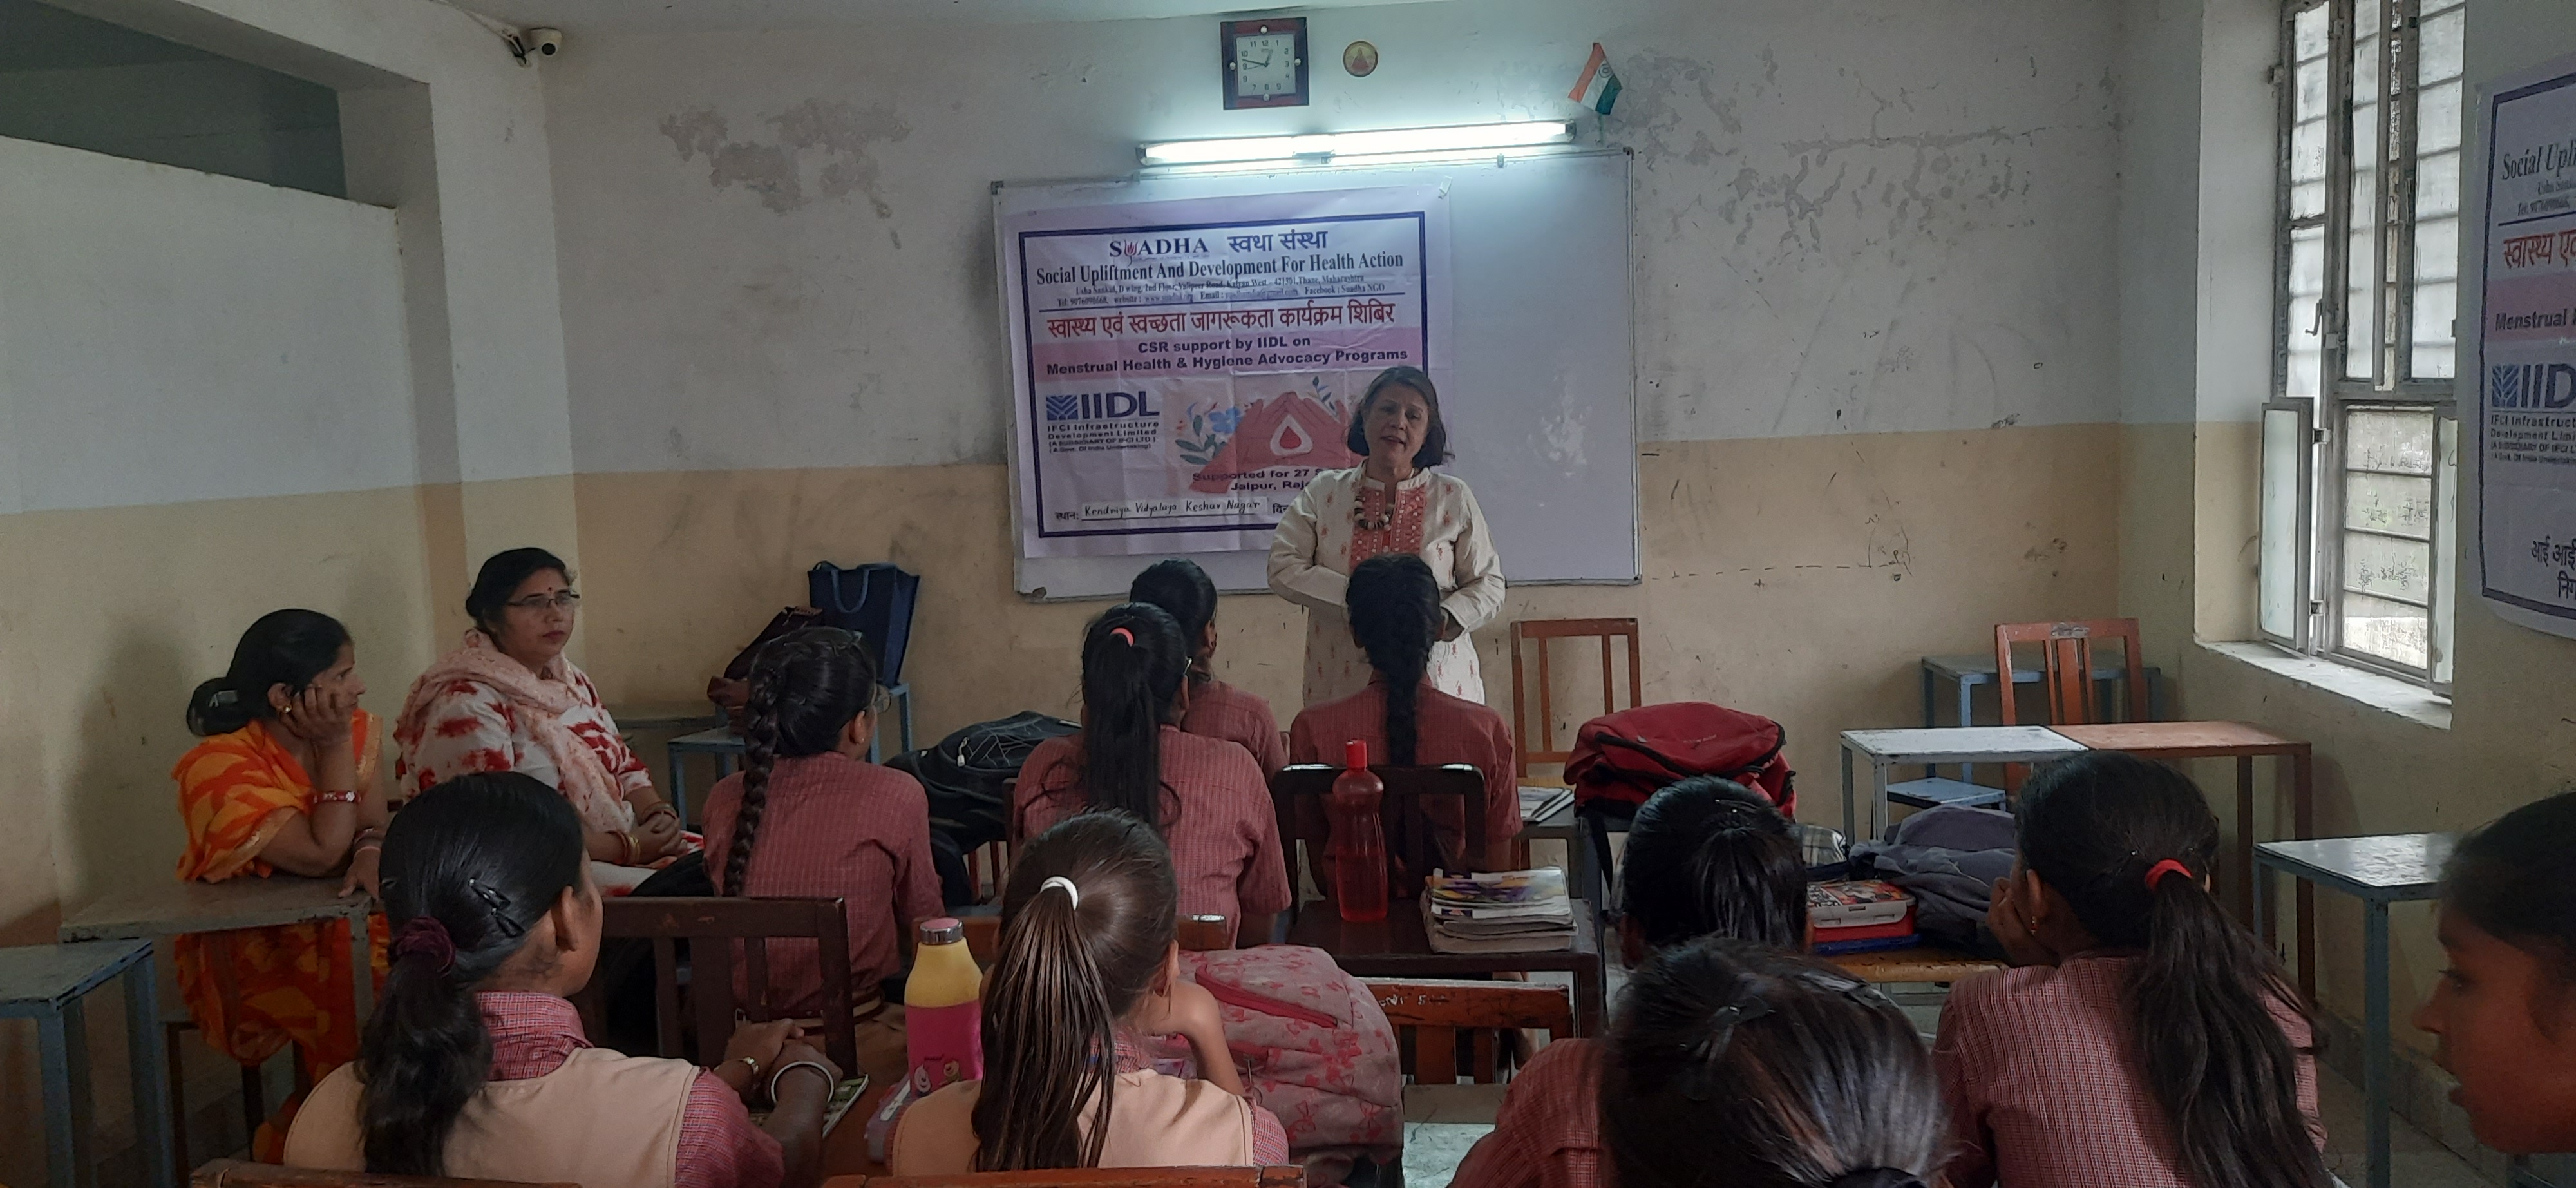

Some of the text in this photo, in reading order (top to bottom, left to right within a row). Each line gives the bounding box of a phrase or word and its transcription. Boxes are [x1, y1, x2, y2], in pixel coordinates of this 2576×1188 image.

[2502, 144, 2544, 180] Social
[1227, 228, 1329, 253] स्वधा संस्था
[2503, 232, 2556, 269] स्वास्थ्य
[1037, 251, 1404, 286] Social Upliftment And Development For Health Action
[1144, 283, 1157, 292] 2nd
[1226, 279, 1250, 289] Kalyan
[1251, 278, 1267, 287] West
[1322, 274, 1365, 284] Maharashtra
[1200, 291, 1220, 300] Email
[1304, 284, 1336, 295] Facebook
[1367, 282, 1385, 292] NGO
[1046, 298, 1396, 338] स्वास्थ्य एवं स्वच्छता जागरूकता कार्यक्रम शिबिर
[2496, 309, 2567, 331] Menstrual
[1137, 336, 1311, 354] CSR support by IIDL on
[1046, 349, 1408, 375] Menstrual Health & Hygiene Advocacy Programs
[1081, 390, 1160, 419] IIDL
[1047, 421, 1159, 432] IFCI Infrastructure
[2490, 414, 2508, 425] IFCI
[1048, 428, 1157, 439] Development Limited
[2490, 428, 2548, 441] Development
[2539, 443, 2550, 452] OF
[1192, 470, 1265, 482] Supported
[1271, 470, 1289, 478] for
[1294, 469, 1310, 477] 27
[1231, 481, 1276, 492] Jaipur,
[1226, 497, 1262, 515] Nagar
[2531, 535, 2550, 567] आई
